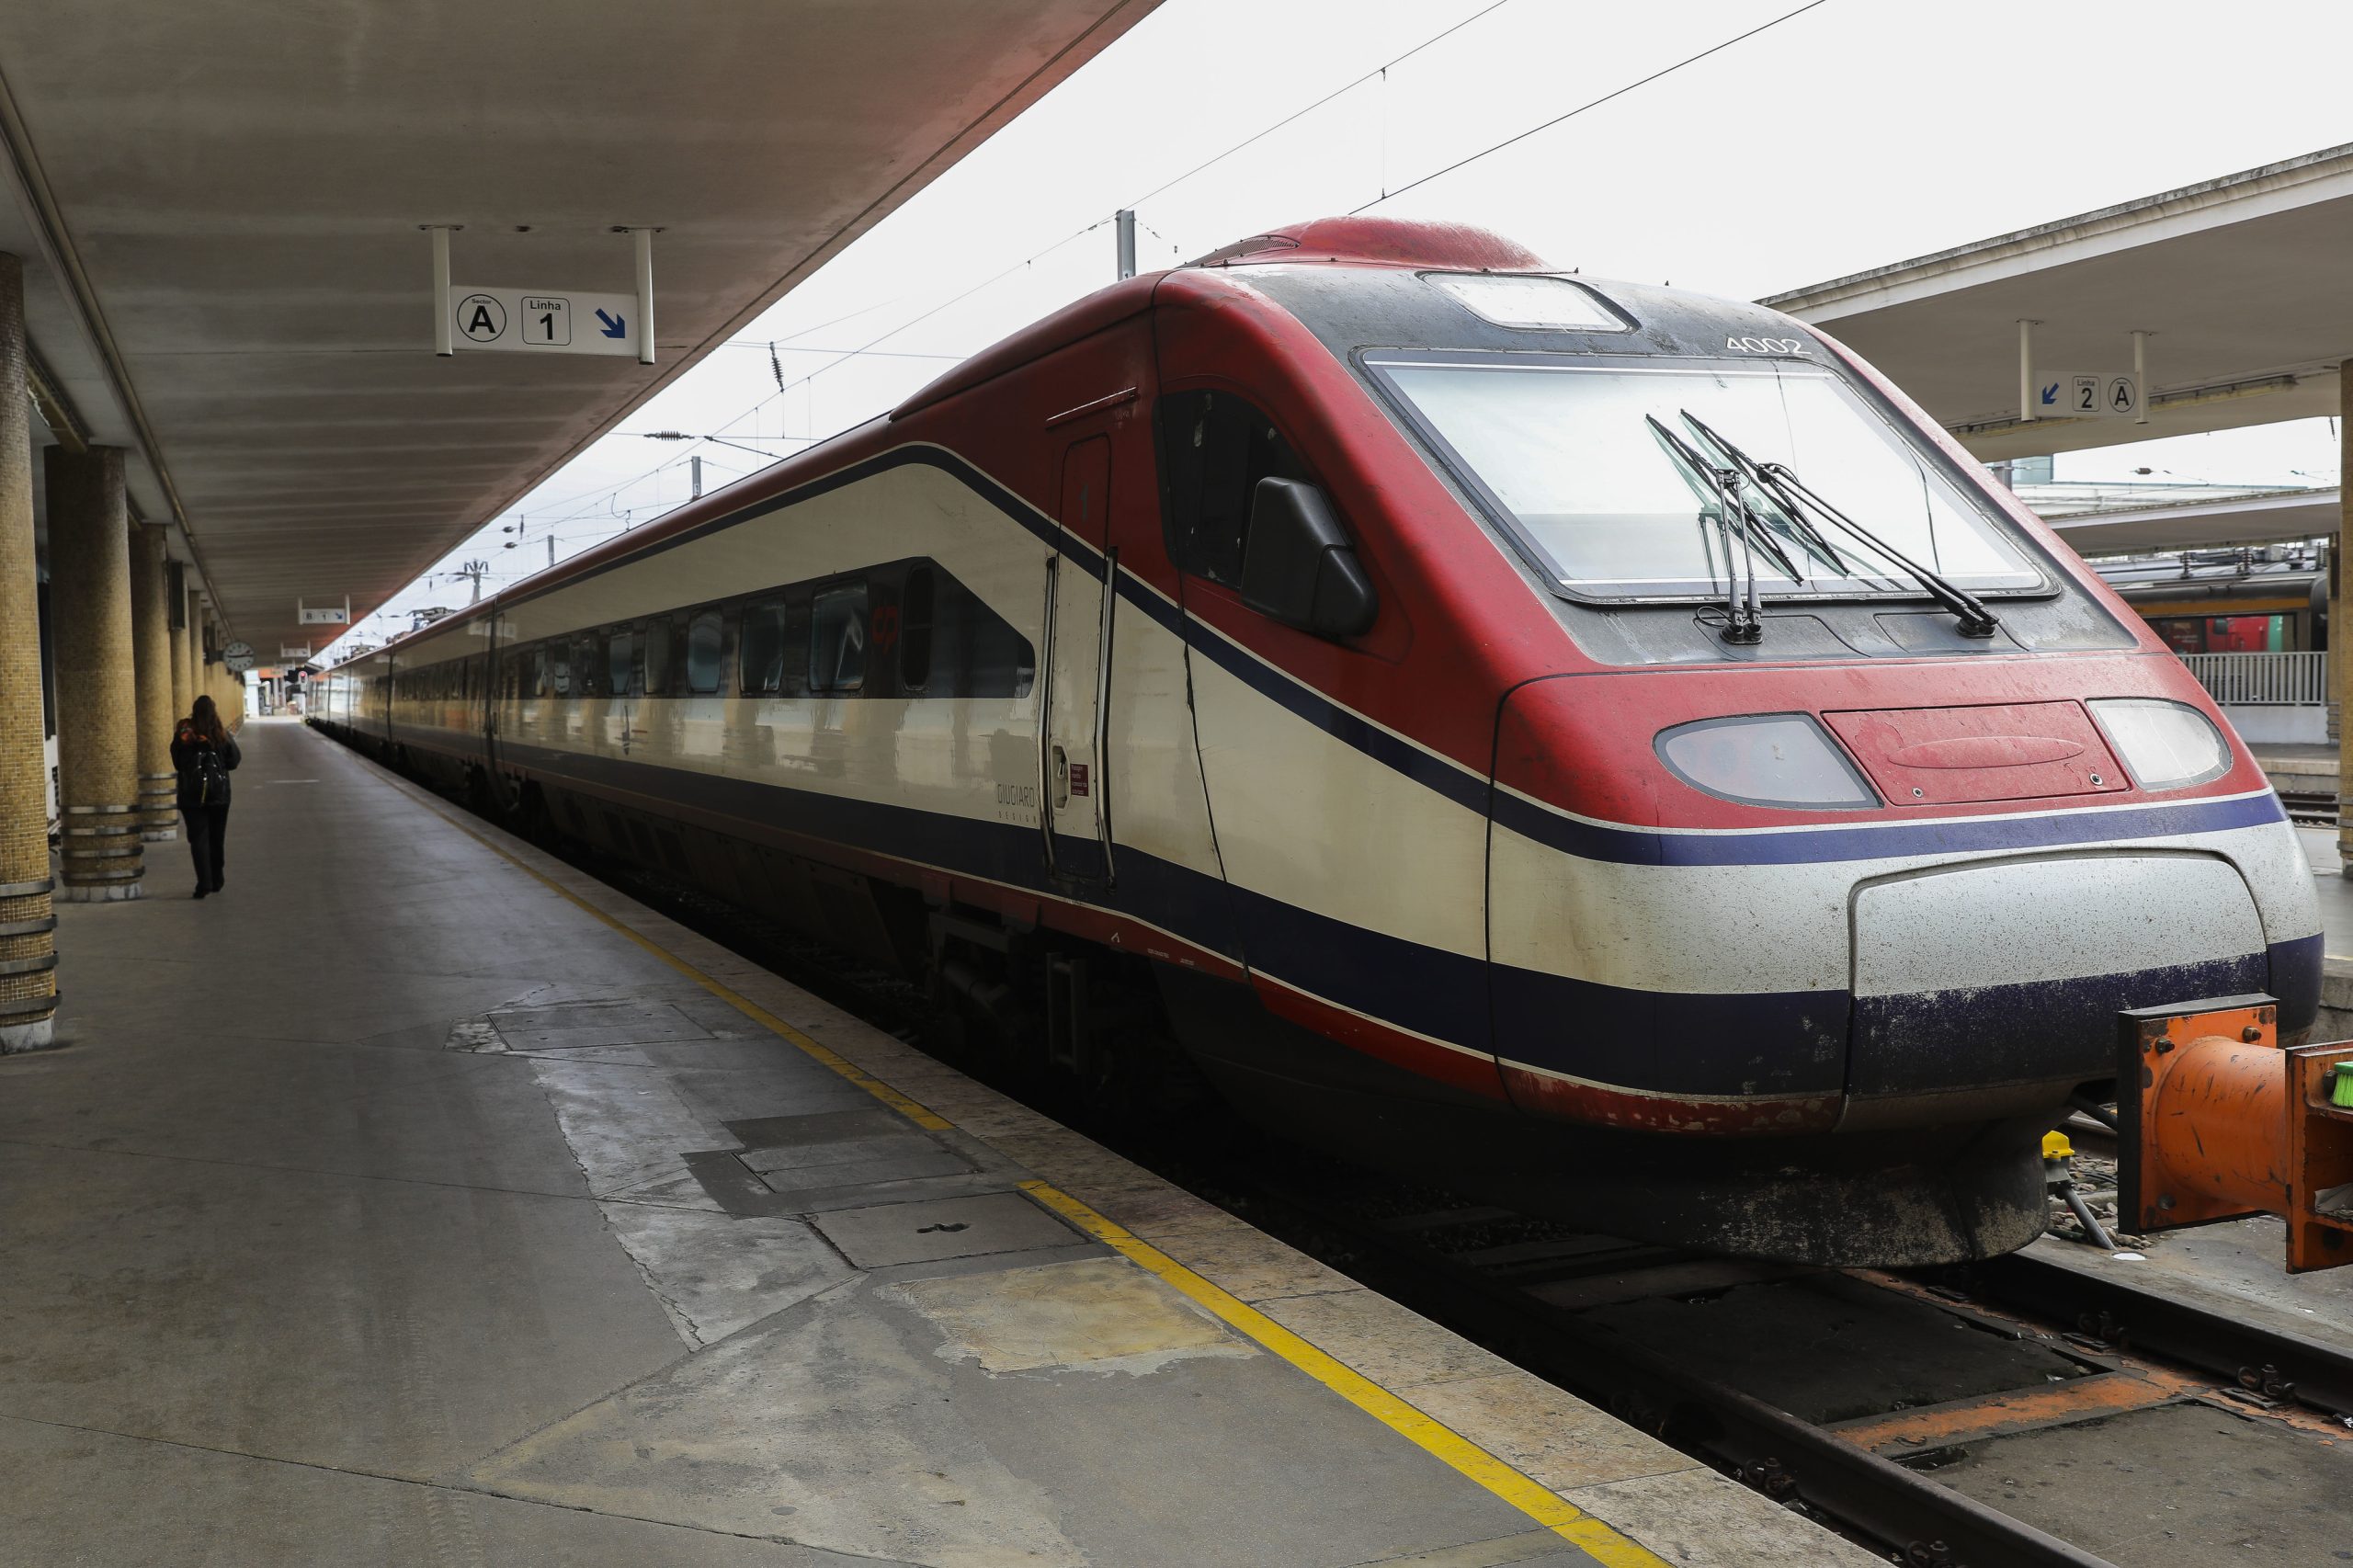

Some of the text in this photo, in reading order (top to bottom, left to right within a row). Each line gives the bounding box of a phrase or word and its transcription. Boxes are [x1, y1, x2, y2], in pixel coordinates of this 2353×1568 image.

[529, 300, 562, 311] Linha
[468, 304, 496, 334] A
[540, 312, 553, 340] 1
[1726, 336, 1812, 355] 4002
[2081, 387, 2093, 409] 2
[2114, 385, 2130, 406] A
[997, 783, 1035, 808] GIUGIARO
